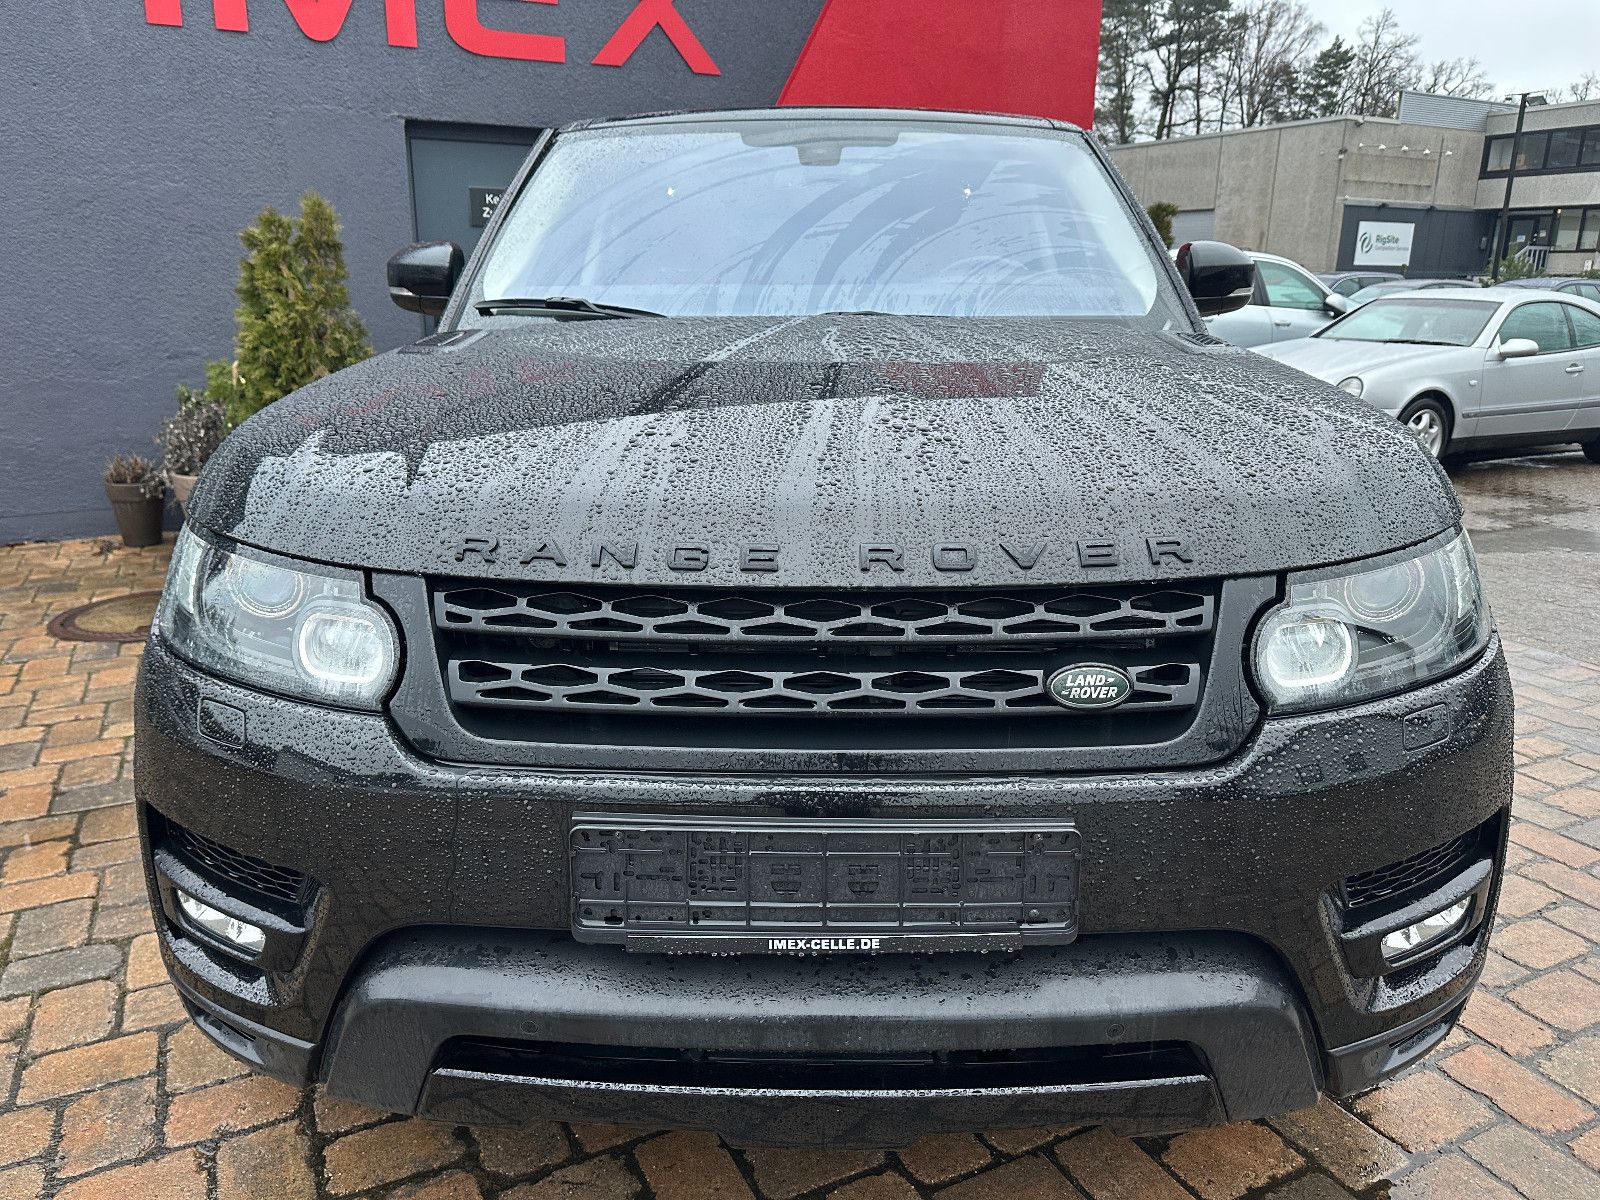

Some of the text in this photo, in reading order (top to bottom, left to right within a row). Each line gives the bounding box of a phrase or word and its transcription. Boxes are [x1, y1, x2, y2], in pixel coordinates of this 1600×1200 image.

[485, 193, 502, 205] Ke
[1375, 233, 1400, 246] RigSite
[454, 533, 1194, 573] RANGE ROVER
[768, 938, 880, 950] IMEX-CELLE.DE
